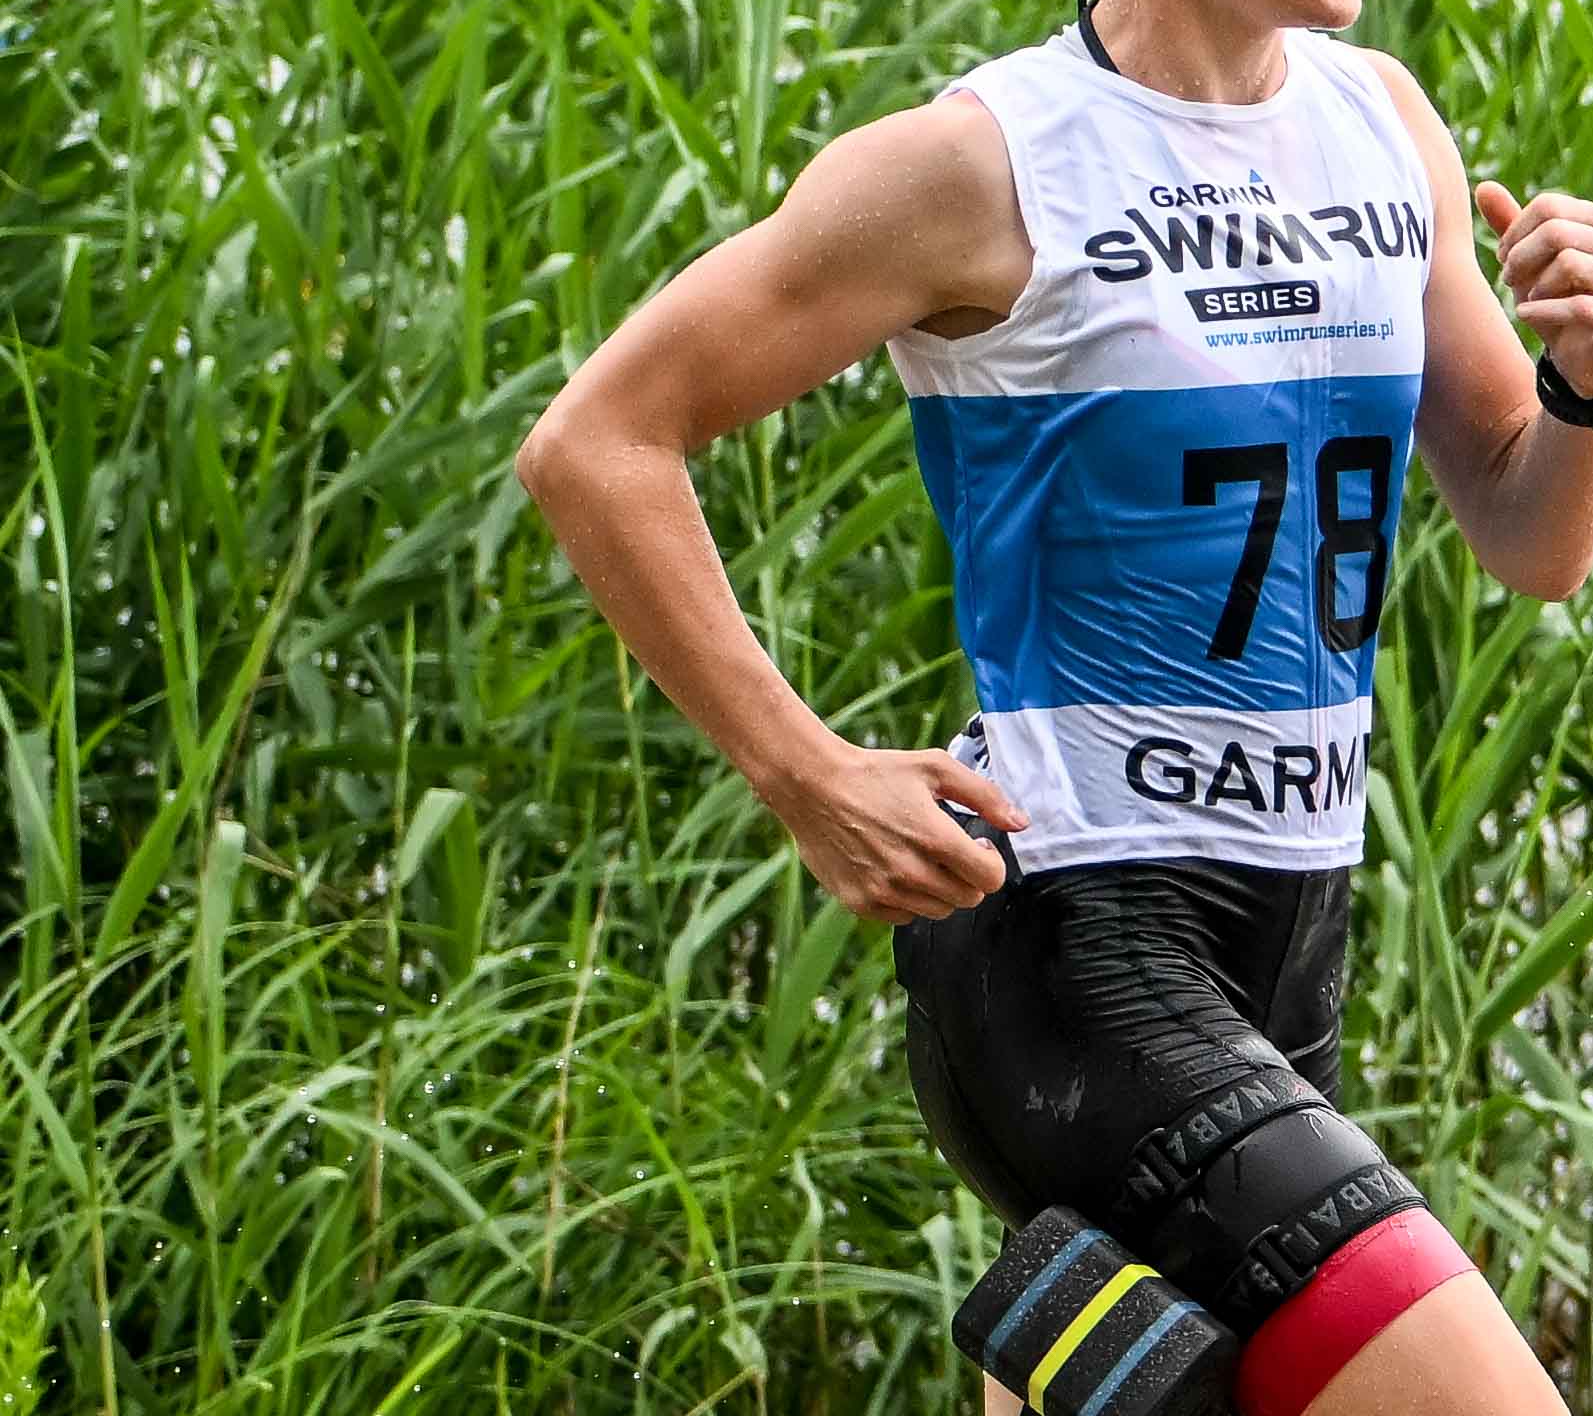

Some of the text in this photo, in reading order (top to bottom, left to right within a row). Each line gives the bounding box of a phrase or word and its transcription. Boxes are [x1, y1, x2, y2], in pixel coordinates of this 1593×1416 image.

[1148, 168, 1277, 209] GARMIN
[1084, 201, 1427, 283] SWIMRUN
[1203, 286, 1314, 315] SERIES
[1205, 318, 1394, 348] www.swimrunseries.pl
[1182, 435, 1393, 661] 78
